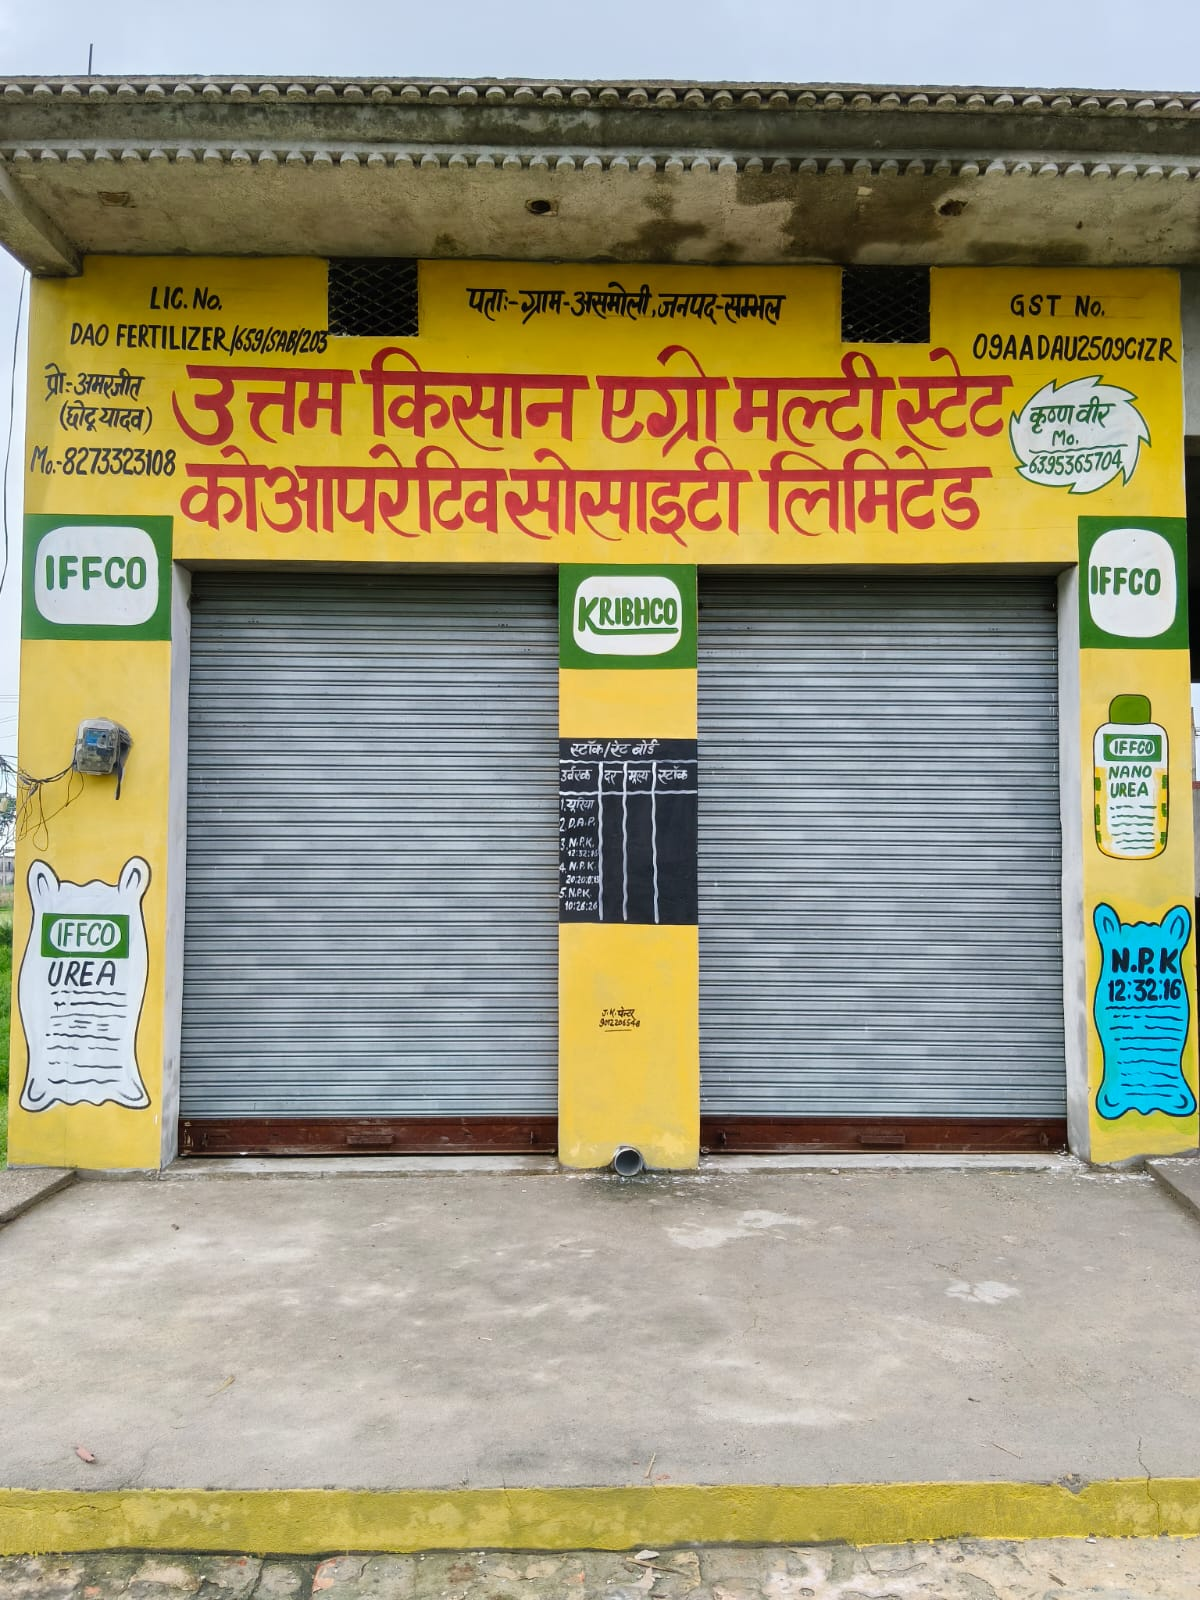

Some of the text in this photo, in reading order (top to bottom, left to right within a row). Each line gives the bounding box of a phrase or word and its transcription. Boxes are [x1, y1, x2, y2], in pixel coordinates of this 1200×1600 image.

[150, 286, 223, 310] LIC. No.
[1010, 294, 1105, 317] GST No.
[70, 323, 109, 347] DAO
[972, 333, 1178, 364] 09AADAU2509C1ZR
[171, 345, 1014, 457] उत्तम किसान एग्रो मल्टी स्टेट
[1076, 394, 1116, 428] वीर
[1052, 429, 1079, 446] Mo.
[1029, 449, 1123, 475] 6395365704
[504, 445, 753, 547] सोसाइटी
[759, 445, 993, 537] लिमिटेड
[45, 555, 147, 591] IFFCO
[1090, 565, 1161, 596] IFFCO
[578, 596, 679, 636] KRIBHCO
[1114, 740, 1154, 755] IFFCO
[604, 769, 623, 784] दर
[1108, 765, 1152, 780] NANO
[1110, 781, 1149, 798] UREA
[57, 922, 116, 947] IFFCO
[48, 960, 117, 987] UREA
[1108, 978, 1182, 1003] 12:32:16
